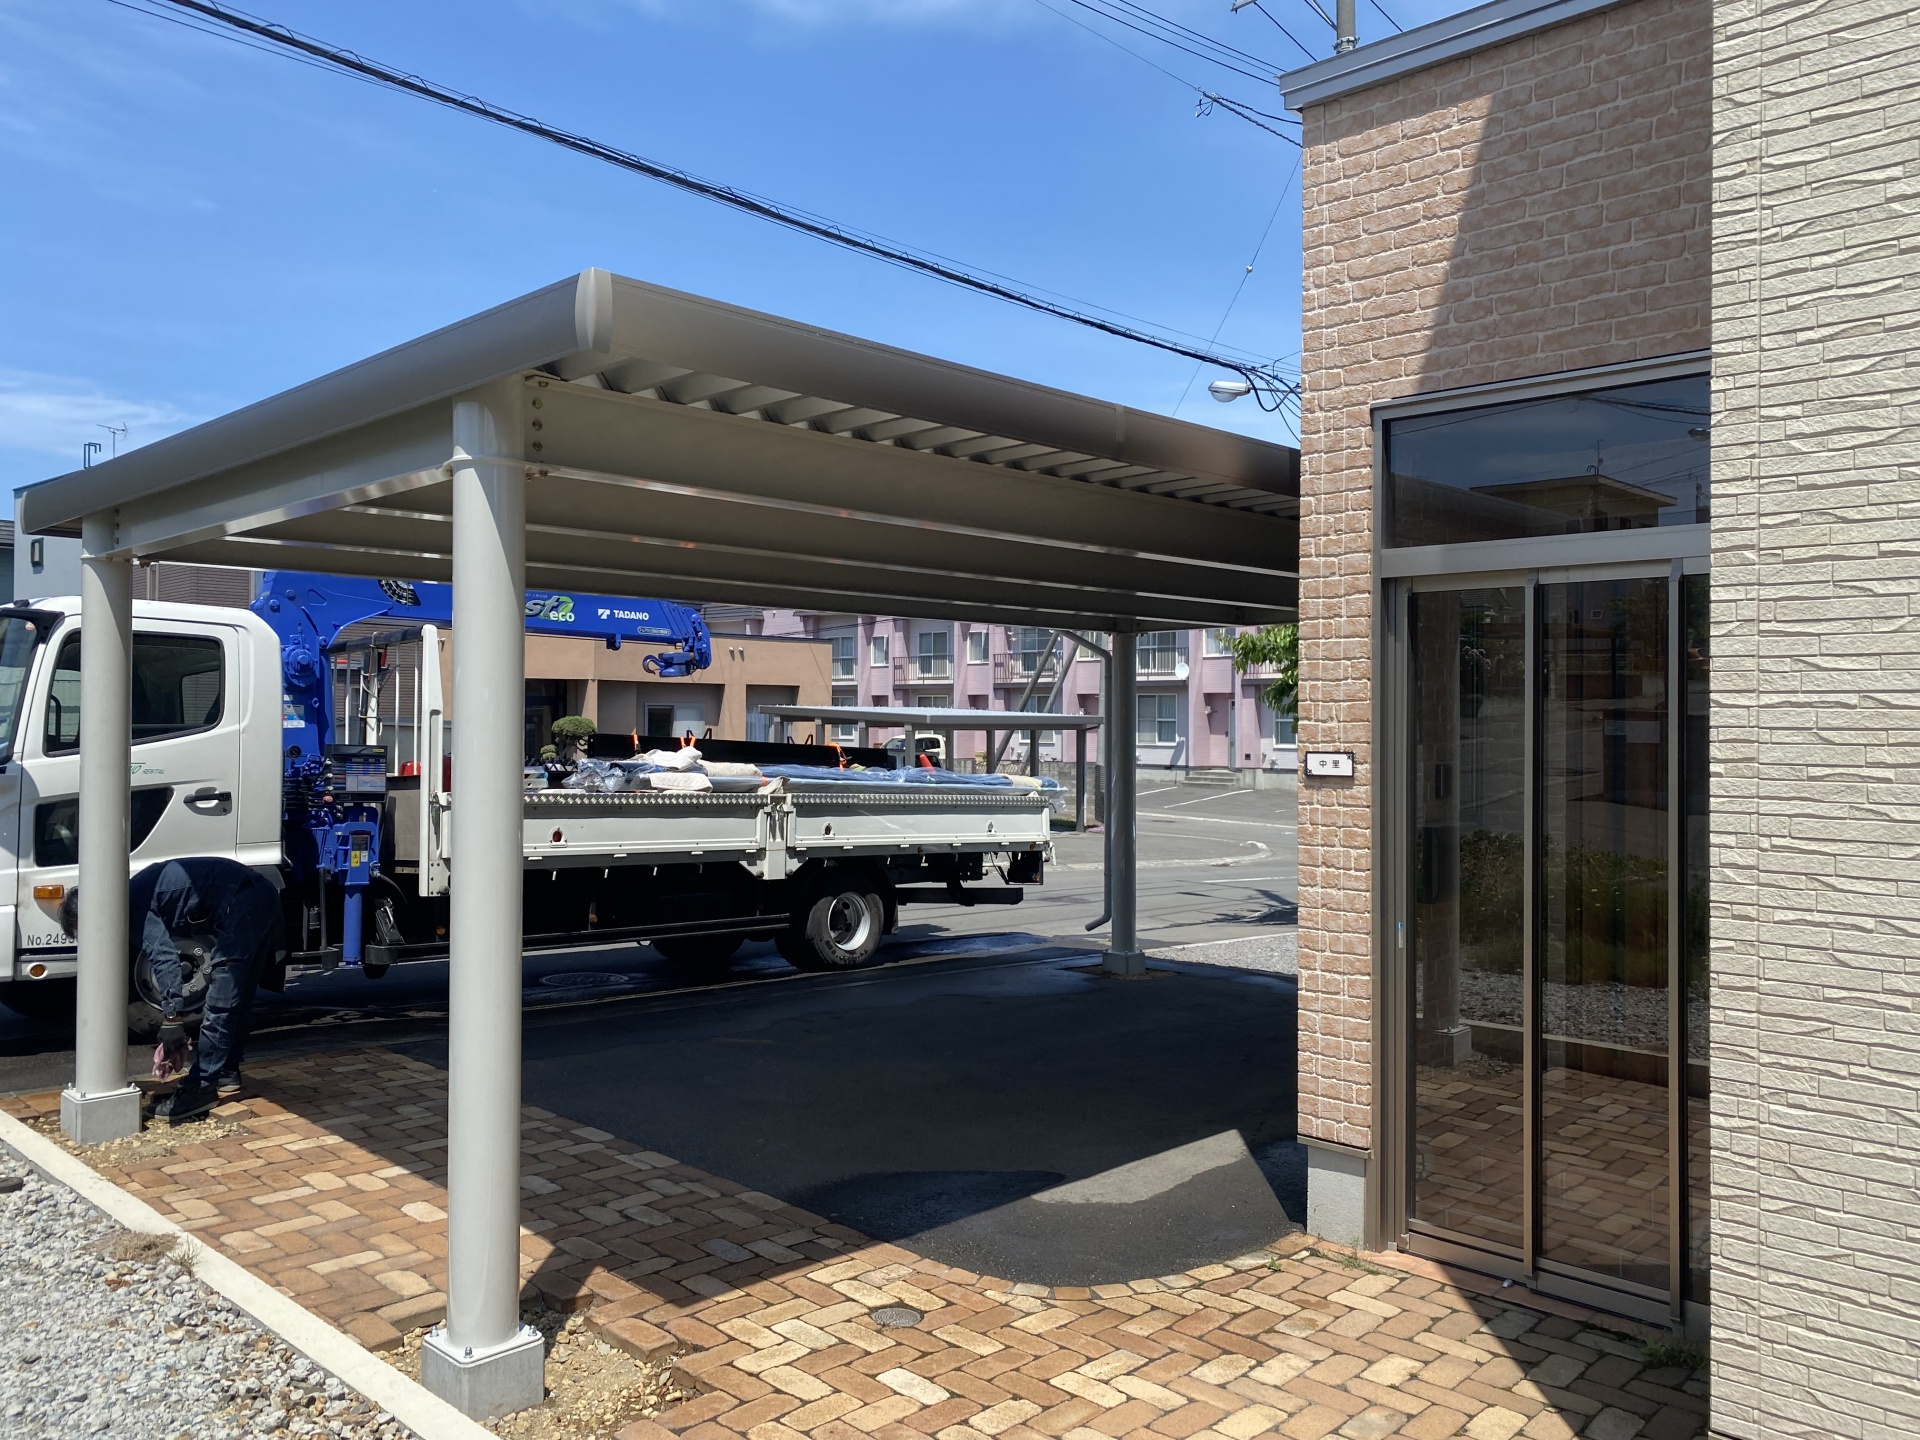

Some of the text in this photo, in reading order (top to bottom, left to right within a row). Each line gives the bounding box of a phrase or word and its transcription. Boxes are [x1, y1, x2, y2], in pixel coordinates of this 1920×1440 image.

[550, 611, 575, 622] eco
[613, 609, 649, 621] TADANO
[1319, 760, 1341, 769] 中里
